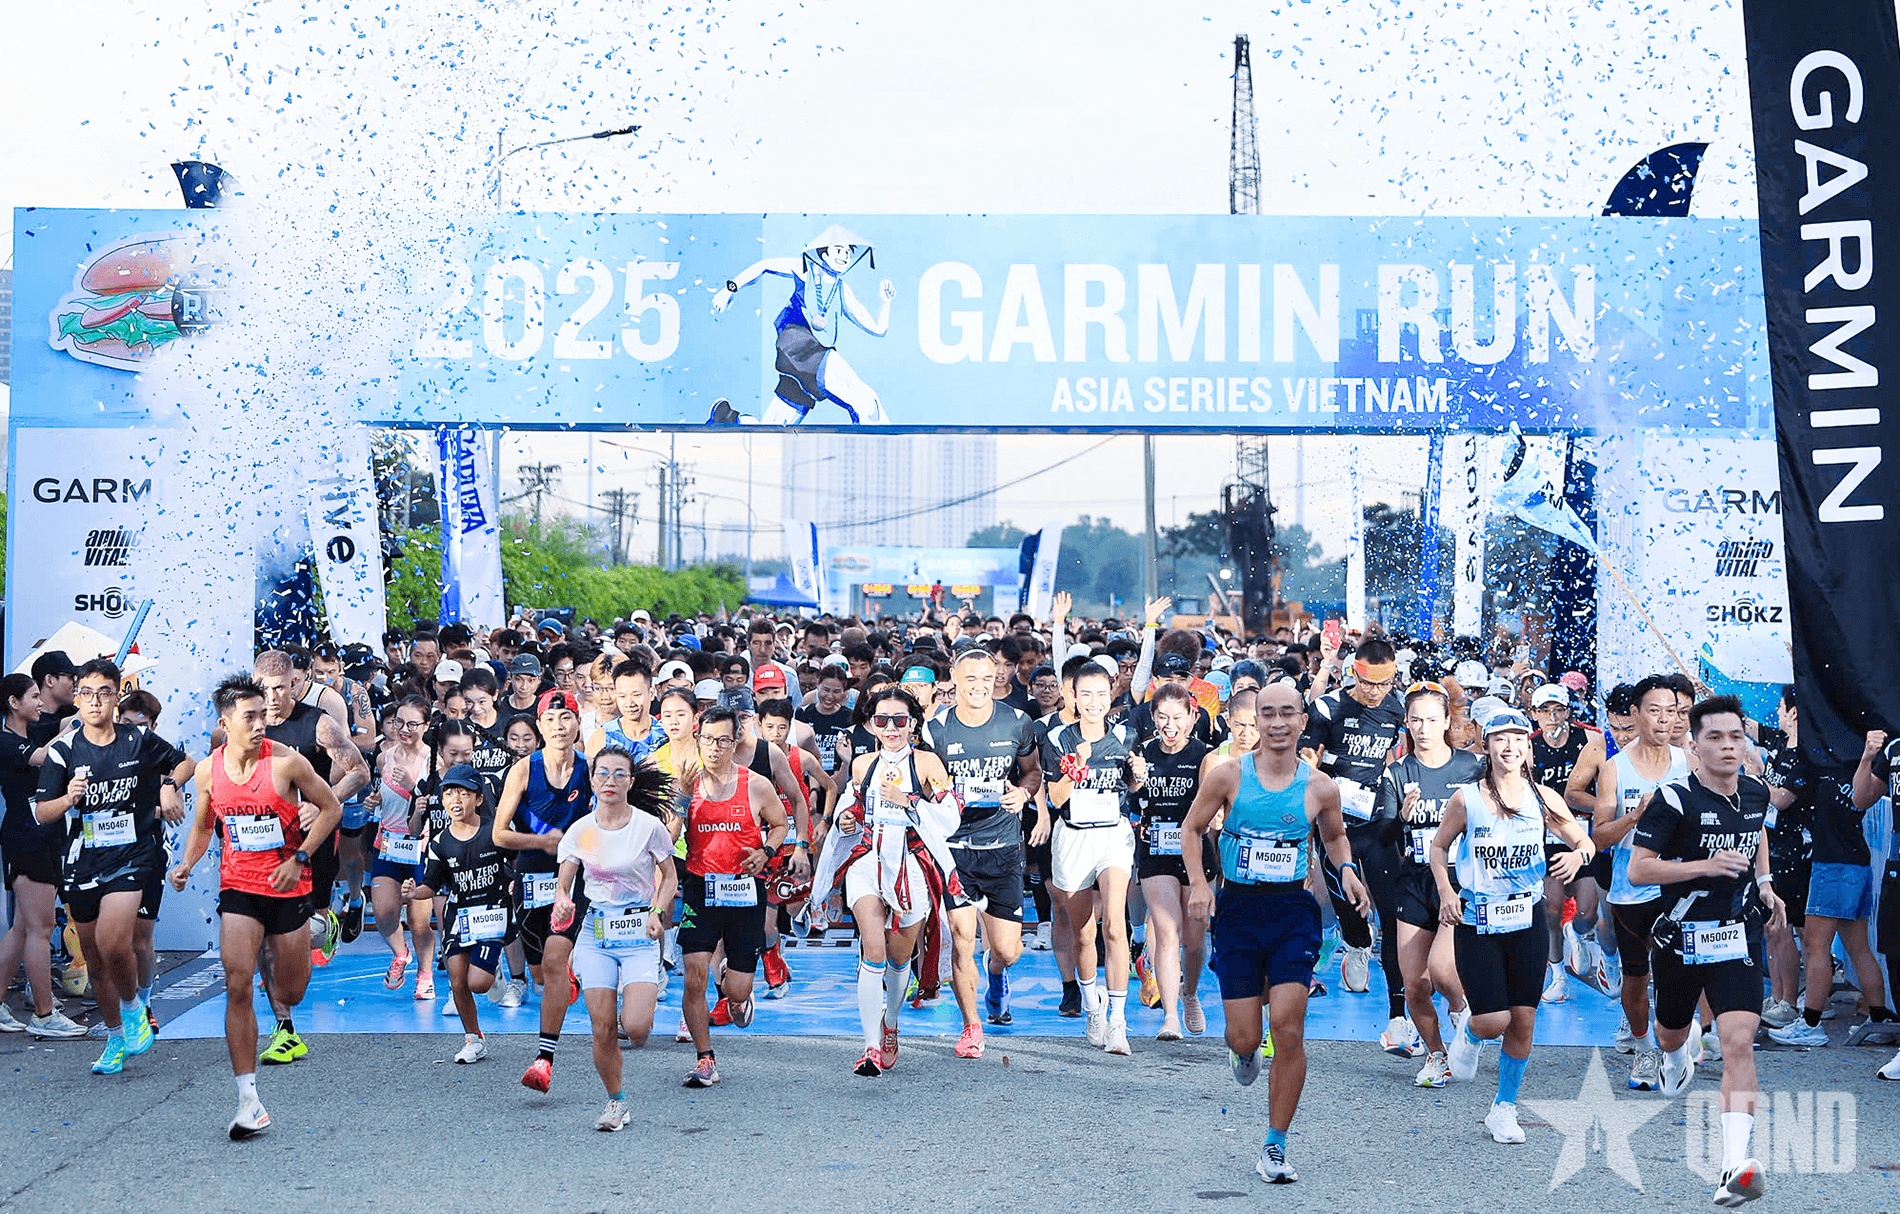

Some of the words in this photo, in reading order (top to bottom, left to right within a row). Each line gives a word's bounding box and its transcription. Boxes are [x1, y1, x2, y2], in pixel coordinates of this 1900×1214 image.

[1790, 49, 1885, 524] GARMIN
[413, 257, 680, 362] 2025
[918, 261, 1339, 364] GARMIN
[1377, 263, 1595, 364] RUN
[1050, 377, 1134, 412] ASIA
[1143, 376, 1272, 412] SERIES
[1281, 376, 1447, 412] VIETNAM
[1716, 537, 1774, 558] amino
[1715, 559, 1757, 577] VITAL
[1706, 601, 1782, 625] SHOKZ
[1342, 733, 1371, 746] FROM
[1347, 744, 1361, 756] TO
[1361, 746, 1386, 759] HERO
[472, 759, 482, 768] TO
[484, 757, 506, 767] HERO
[948, 758, 980, 773] FROM
[983, 755, 1012, 769] ZERO
[1100, 767, 1124, 780] ZERO
[112, 776, 138, 792] ZERO
[1090, 779, 1116, 789] HERO
[1170, 777, 1194, 789] ZERO
[85, 793, 99, 806] TO
[101, 789, 130, 804] HERO
[1147, 787, 1160, 797] TO
[1162, 787, 1186, 797] HERO
[432, 819, 443, 829] TO
[1413, 811, 1426, 824] TO
[98, 819, 128, 831] M50467
[241, 824, 274, 834] M50067
[697, 822, 742, 832] UDAQUA
[1699, 833, 1735, 848] FROM
[1255, 851, 1292, 863] M50075
[1475, 846, 1507, 858] FROM
[1512, 843, 1539, 857] ZERO
[1484, 857, 1497, 869] TO
[1501, 856, 1530, 869] HERO
[476, 863, 499, 879] ZERO
[470, 875, 494, 891] HERO
[1495, 904, 1525, 915] F50175
[473, 913, 503, 924] M50086
[610, 918, 642, 929] F50798
[1701, 930, 1738, 943] M50072
